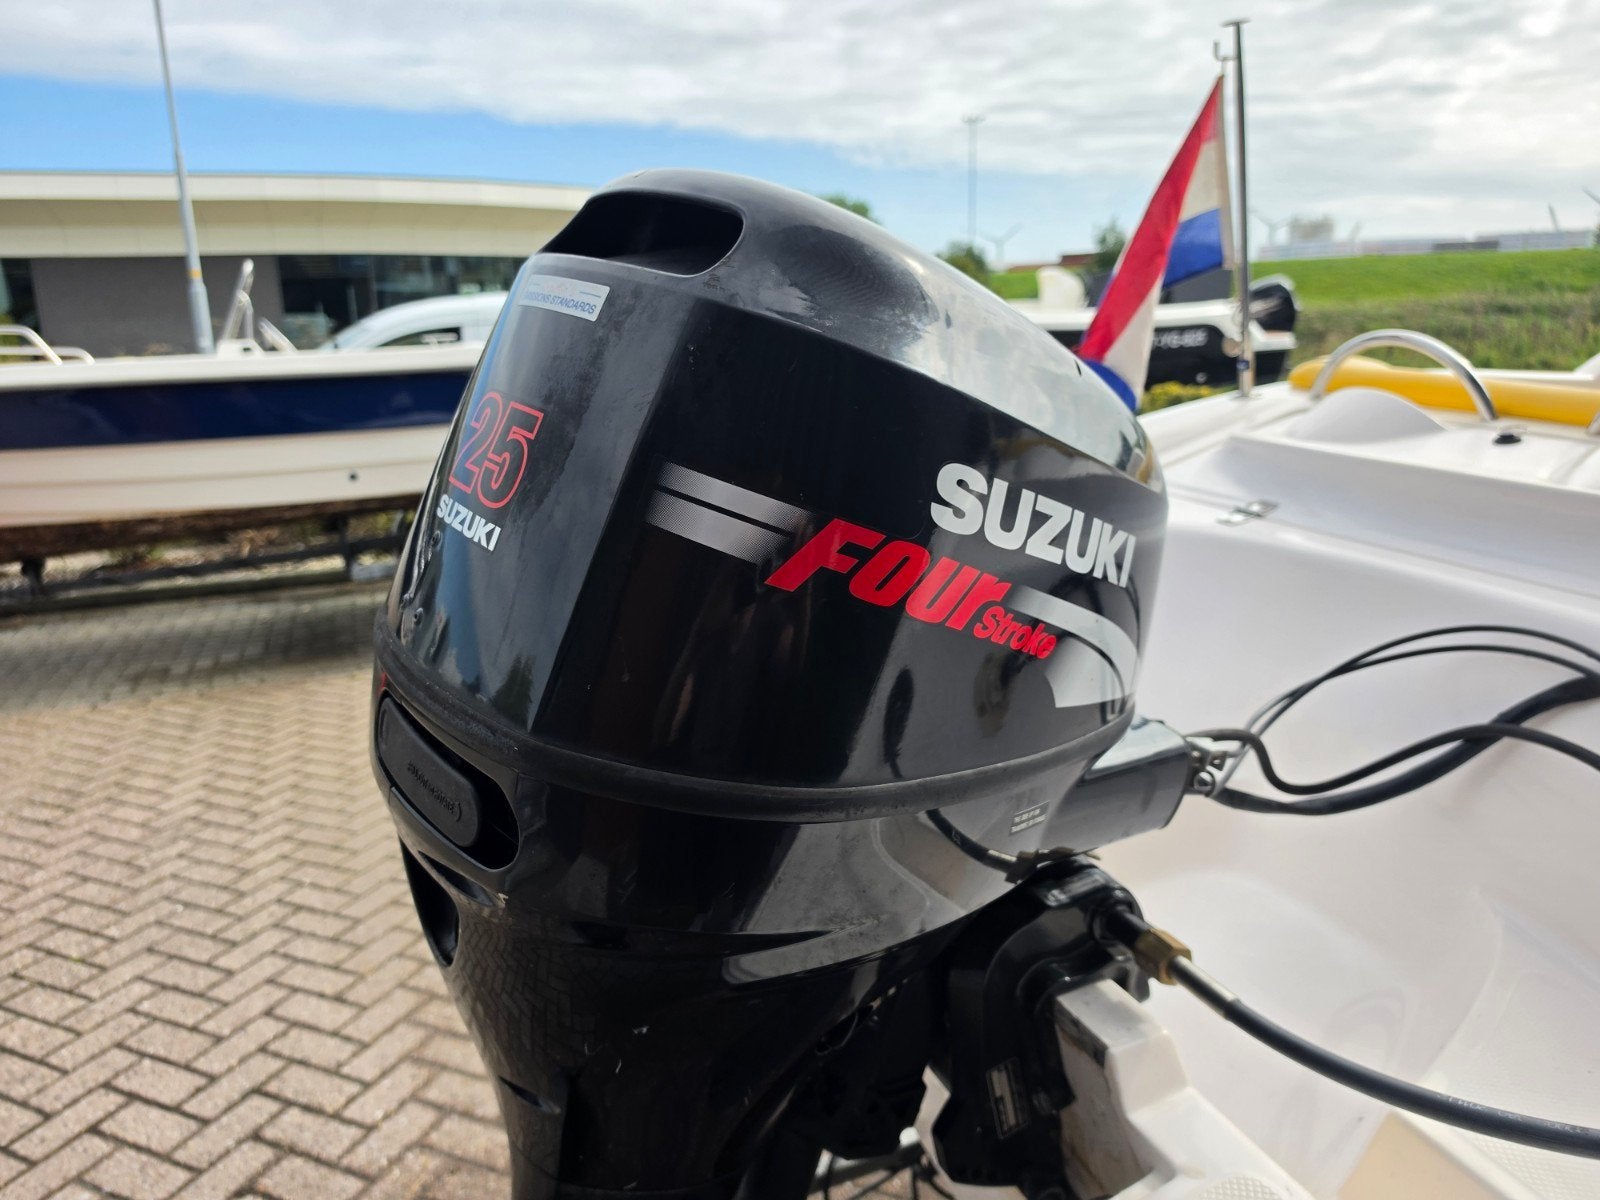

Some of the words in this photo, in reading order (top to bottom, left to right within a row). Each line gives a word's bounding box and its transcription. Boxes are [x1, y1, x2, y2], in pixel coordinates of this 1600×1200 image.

[550, 295, 597, 315] STANDARDS
[449, 391, 544, 509] 25
[436, 494, 502, 552] SUZUKI
[931, 463, 1137, 588] SUZUKI
[973, 604, 1060, 660] Stroke
